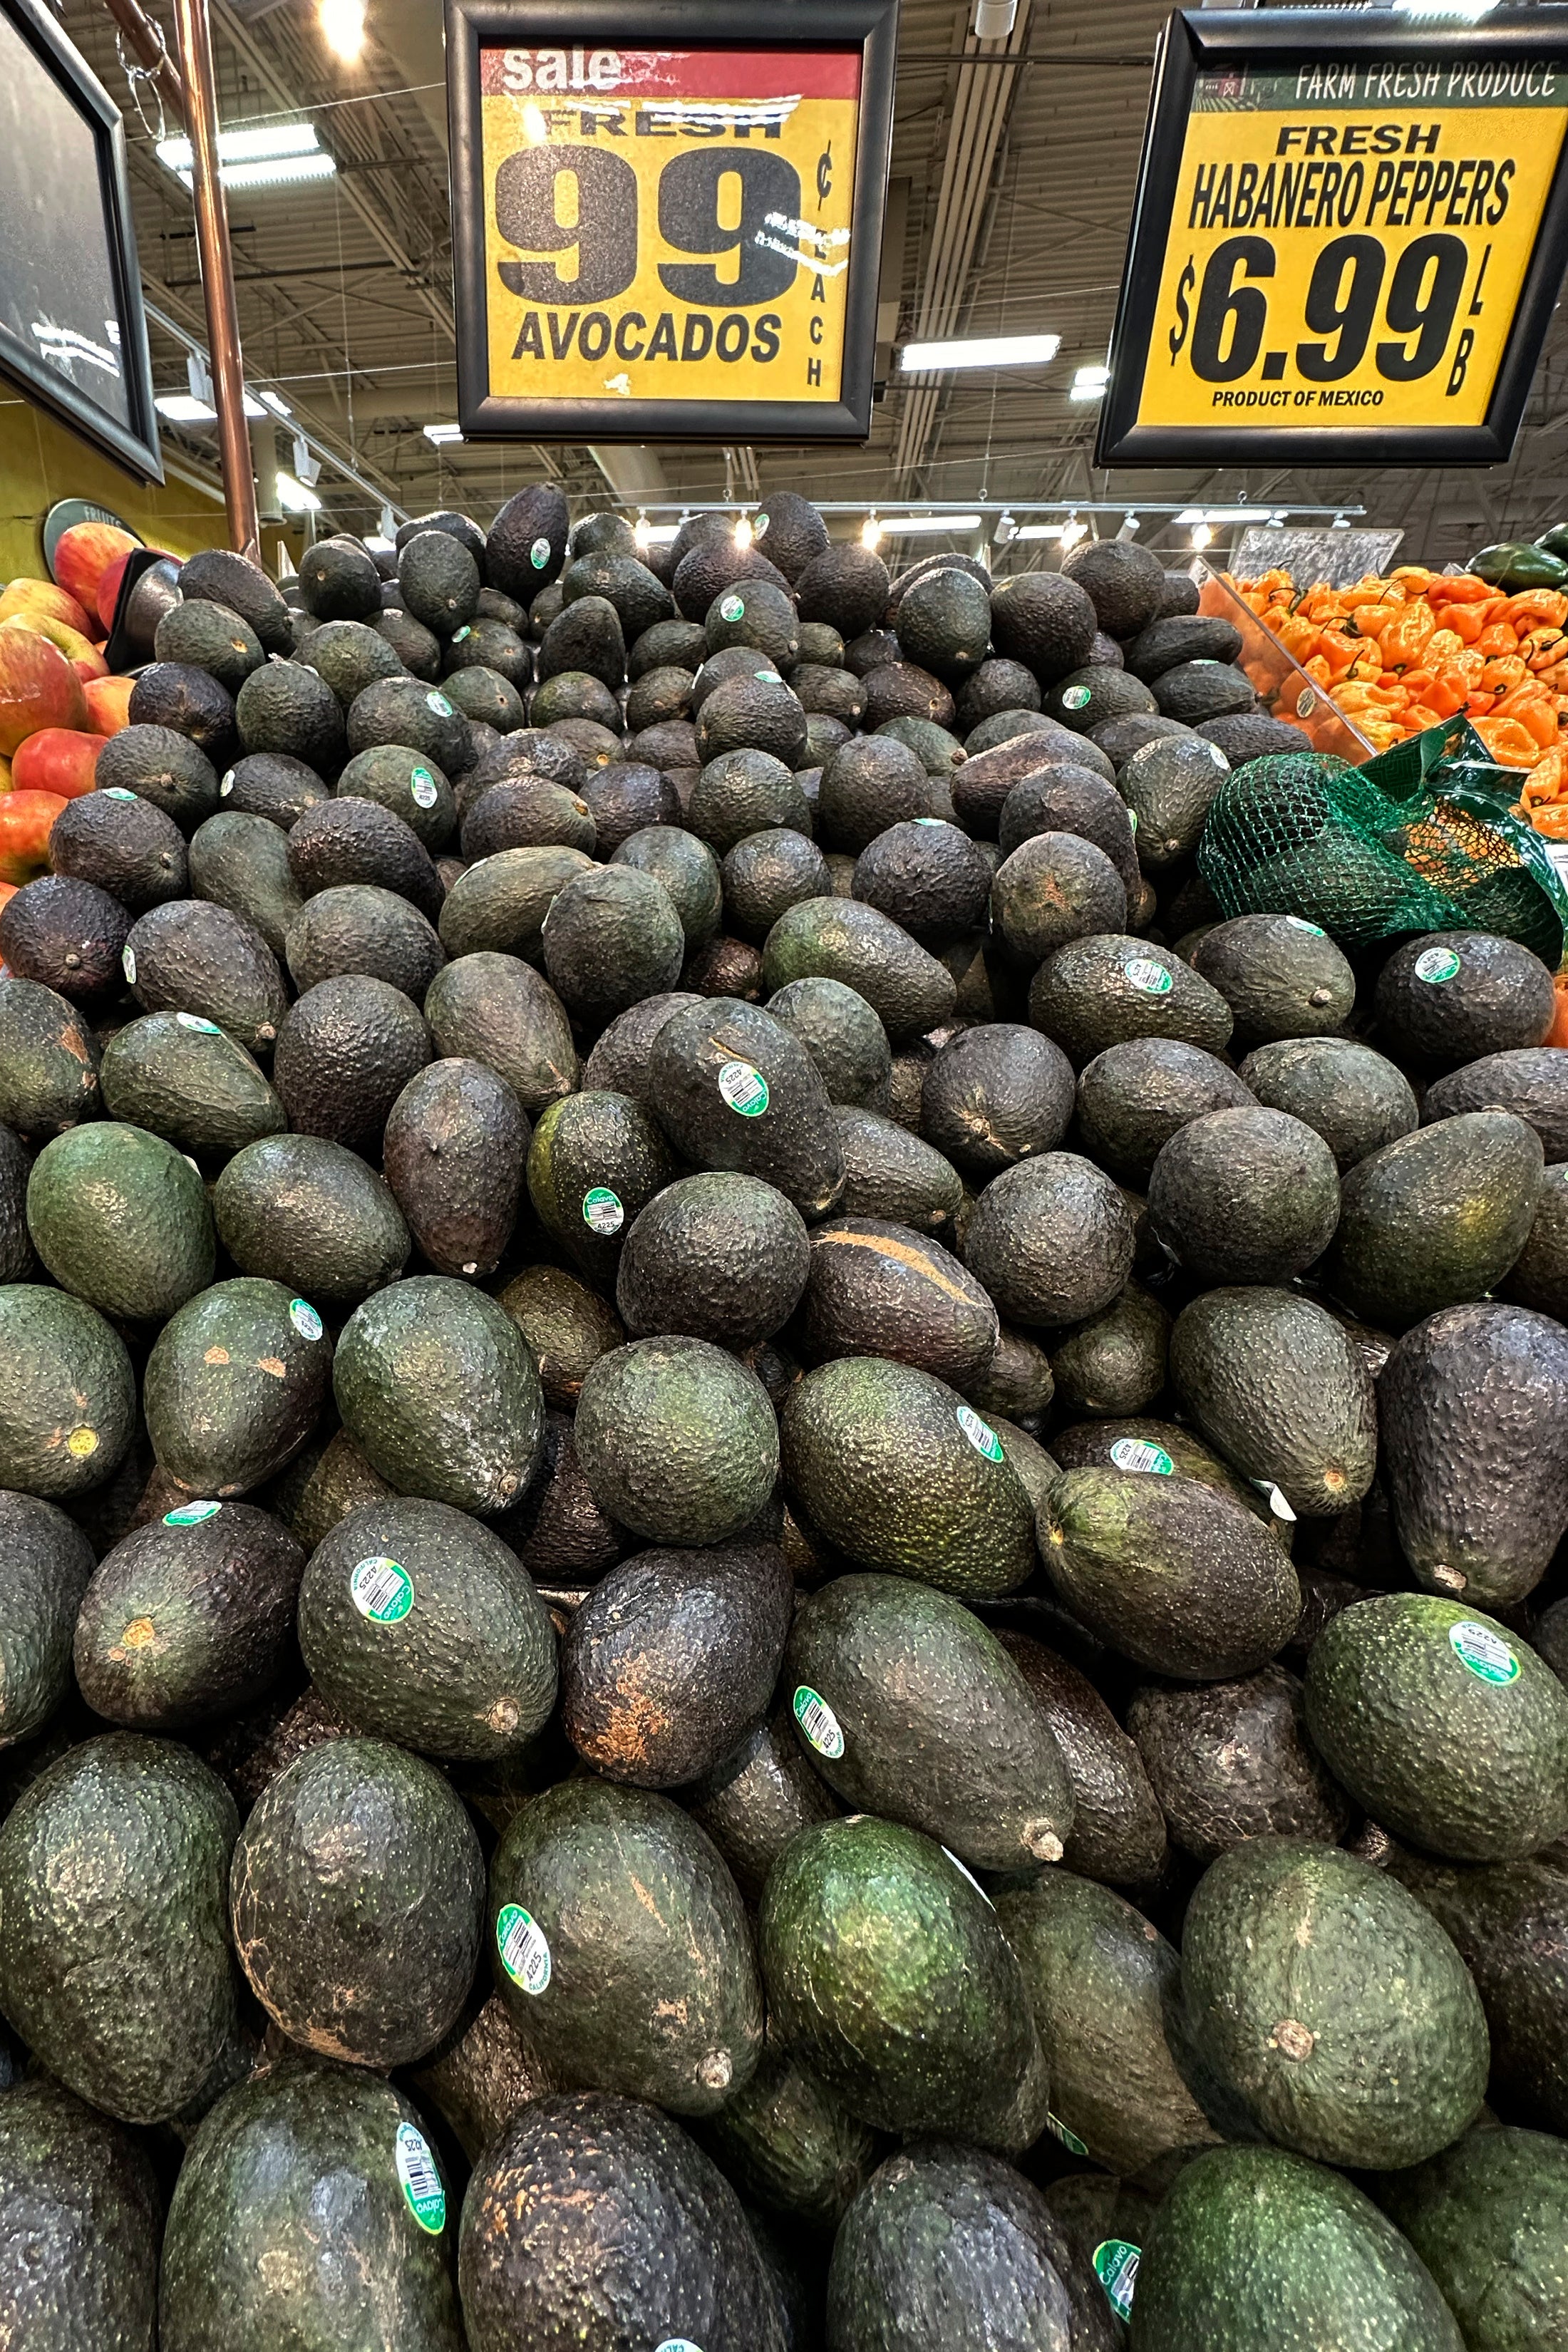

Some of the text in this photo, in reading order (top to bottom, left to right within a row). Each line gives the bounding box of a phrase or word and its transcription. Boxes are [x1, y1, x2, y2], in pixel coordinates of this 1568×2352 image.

[502, 43, 622, 90] sale
[1296, 60, 1561, 99] FARM FRESH PRODUCE
[542, 109, 781, 139] FRESH
[1276, 124, 1441, 156] FRESH
[1187, 159, 1515, 229] HABANERO PEPPERS
[511, 311, 783, 362] AVOCADOS
[1212, 389, 1384, 407] PRODUCT OF MEXICO
[725, 1068, 743, 1085] 4225
[742, 1091, 766, 1112] Calavo
[587, 1195, 614, 1205] Calavo
[597, 1221, 616, 1229] 4225
[1119, 1443, 1133, 1460] 4225
[359, 1565, 378, 1590] 4225
[383, 1584, 411, 1620] Calavo
[795, 1691, 813, 1718] Calavo
[822, 1728, 836, 1749] 4225
[498, 1909, 518, 1947] Calavo
[526, 1951, 542, 1981] 4225
[528, 1951, 549, 1991] CALIFORNIA
[416, 2198, 445, 2214] Calavo
[1098, 2244, 1128, 2286] Calavo
